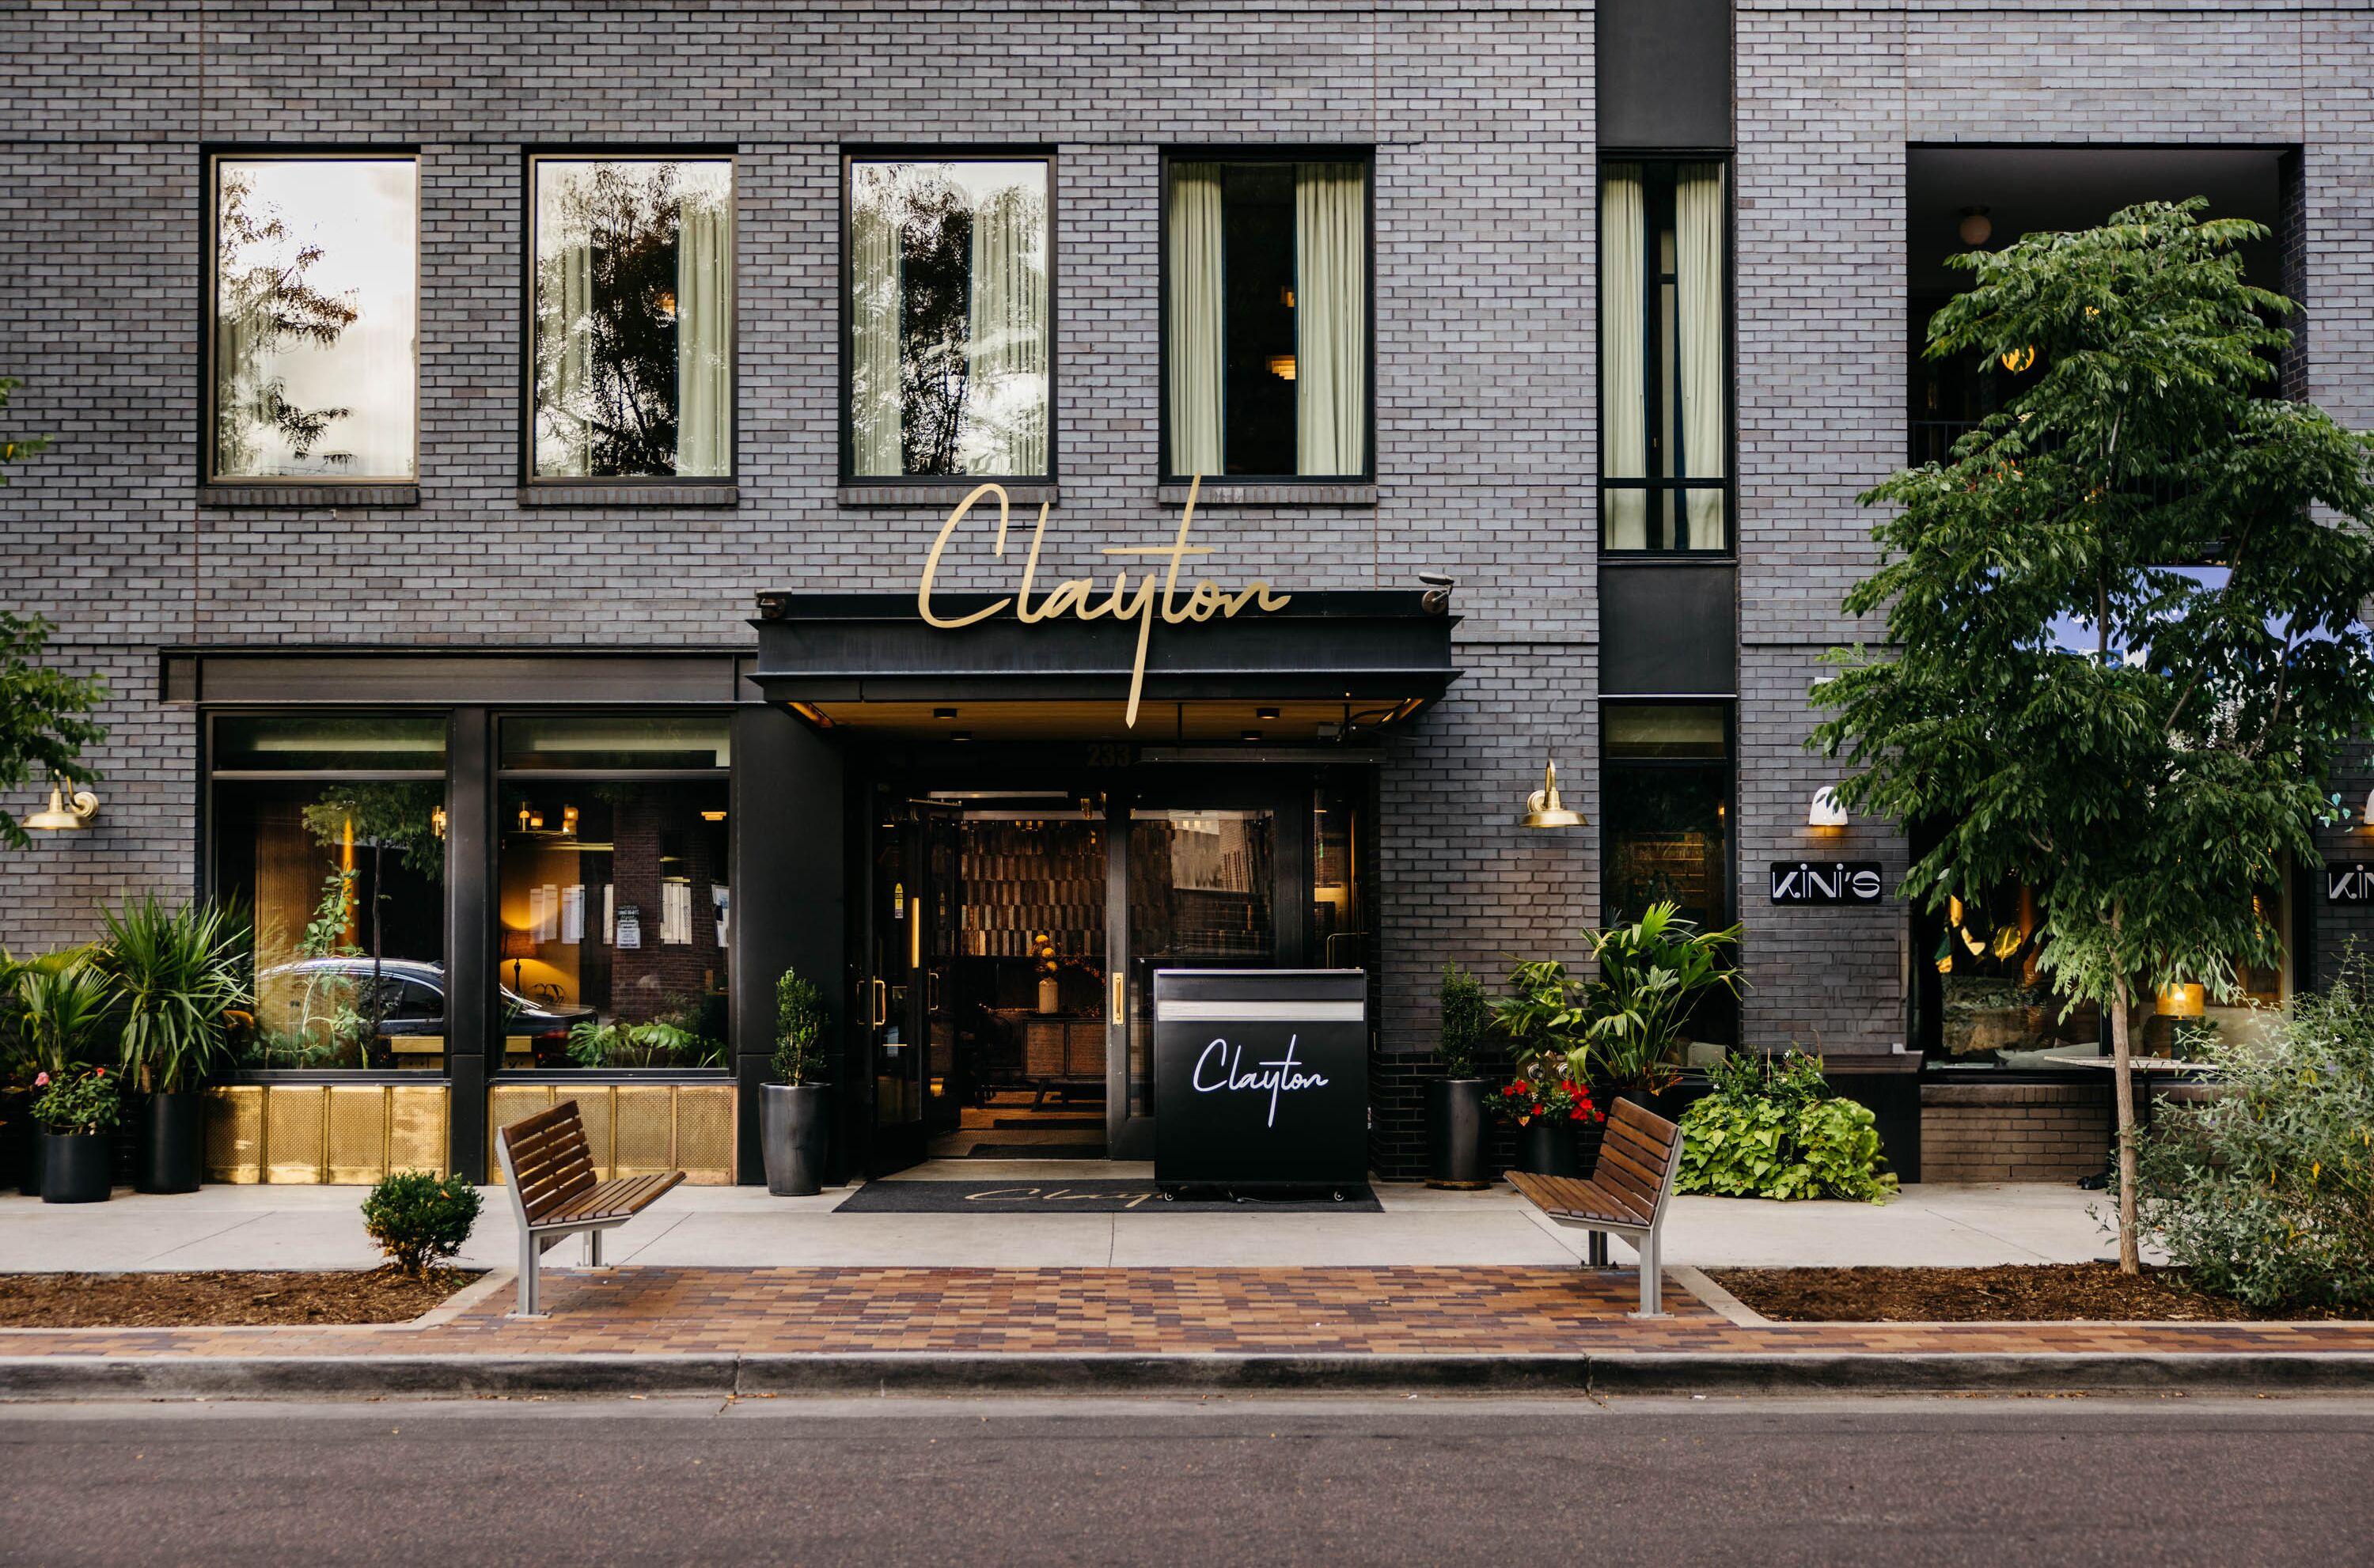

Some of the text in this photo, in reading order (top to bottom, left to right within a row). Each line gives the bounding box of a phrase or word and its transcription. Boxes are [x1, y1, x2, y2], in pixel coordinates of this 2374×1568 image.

[918, 468, 1291, 729] Clayton
[1086, 744, 1131, 767] 233
[1193, 1034, 1329, 1128] Clayton
[965, 1188, 1161, 1208] Clay
